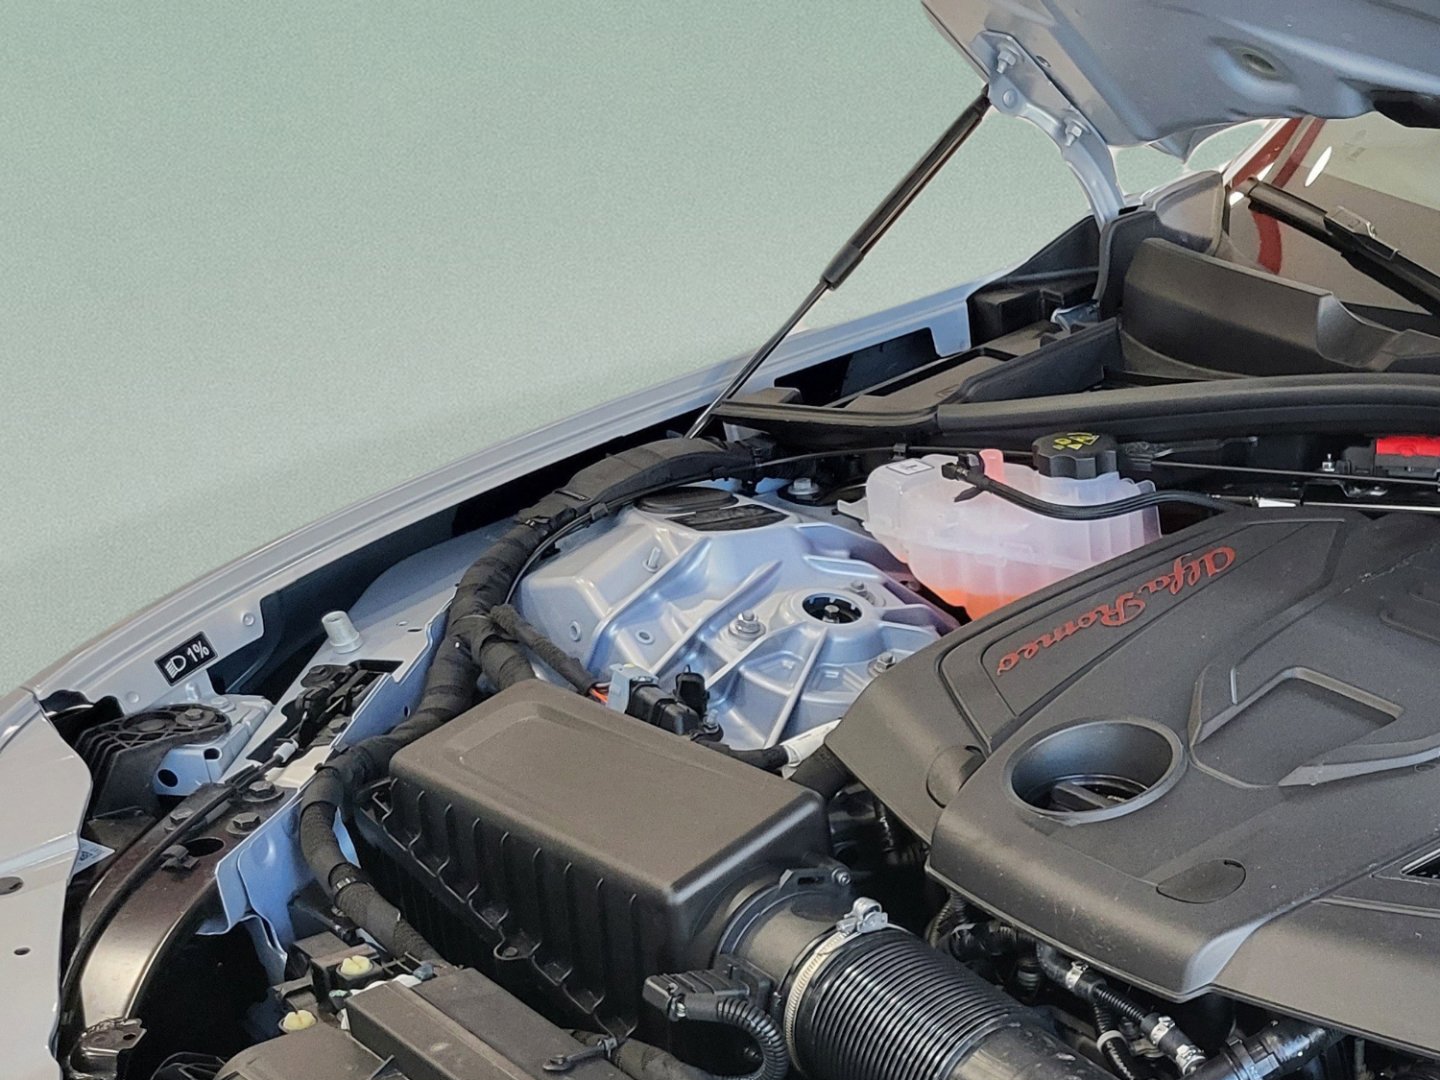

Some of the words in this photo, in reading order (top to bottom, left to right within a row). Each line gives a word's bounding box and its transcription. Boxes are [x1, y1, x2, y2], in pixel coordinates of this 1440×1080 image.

[1139, 546, 1236, 596] Alfa
[186, 640, 210, 662] 1%
[996, 591, 1147, 676] Romeo
